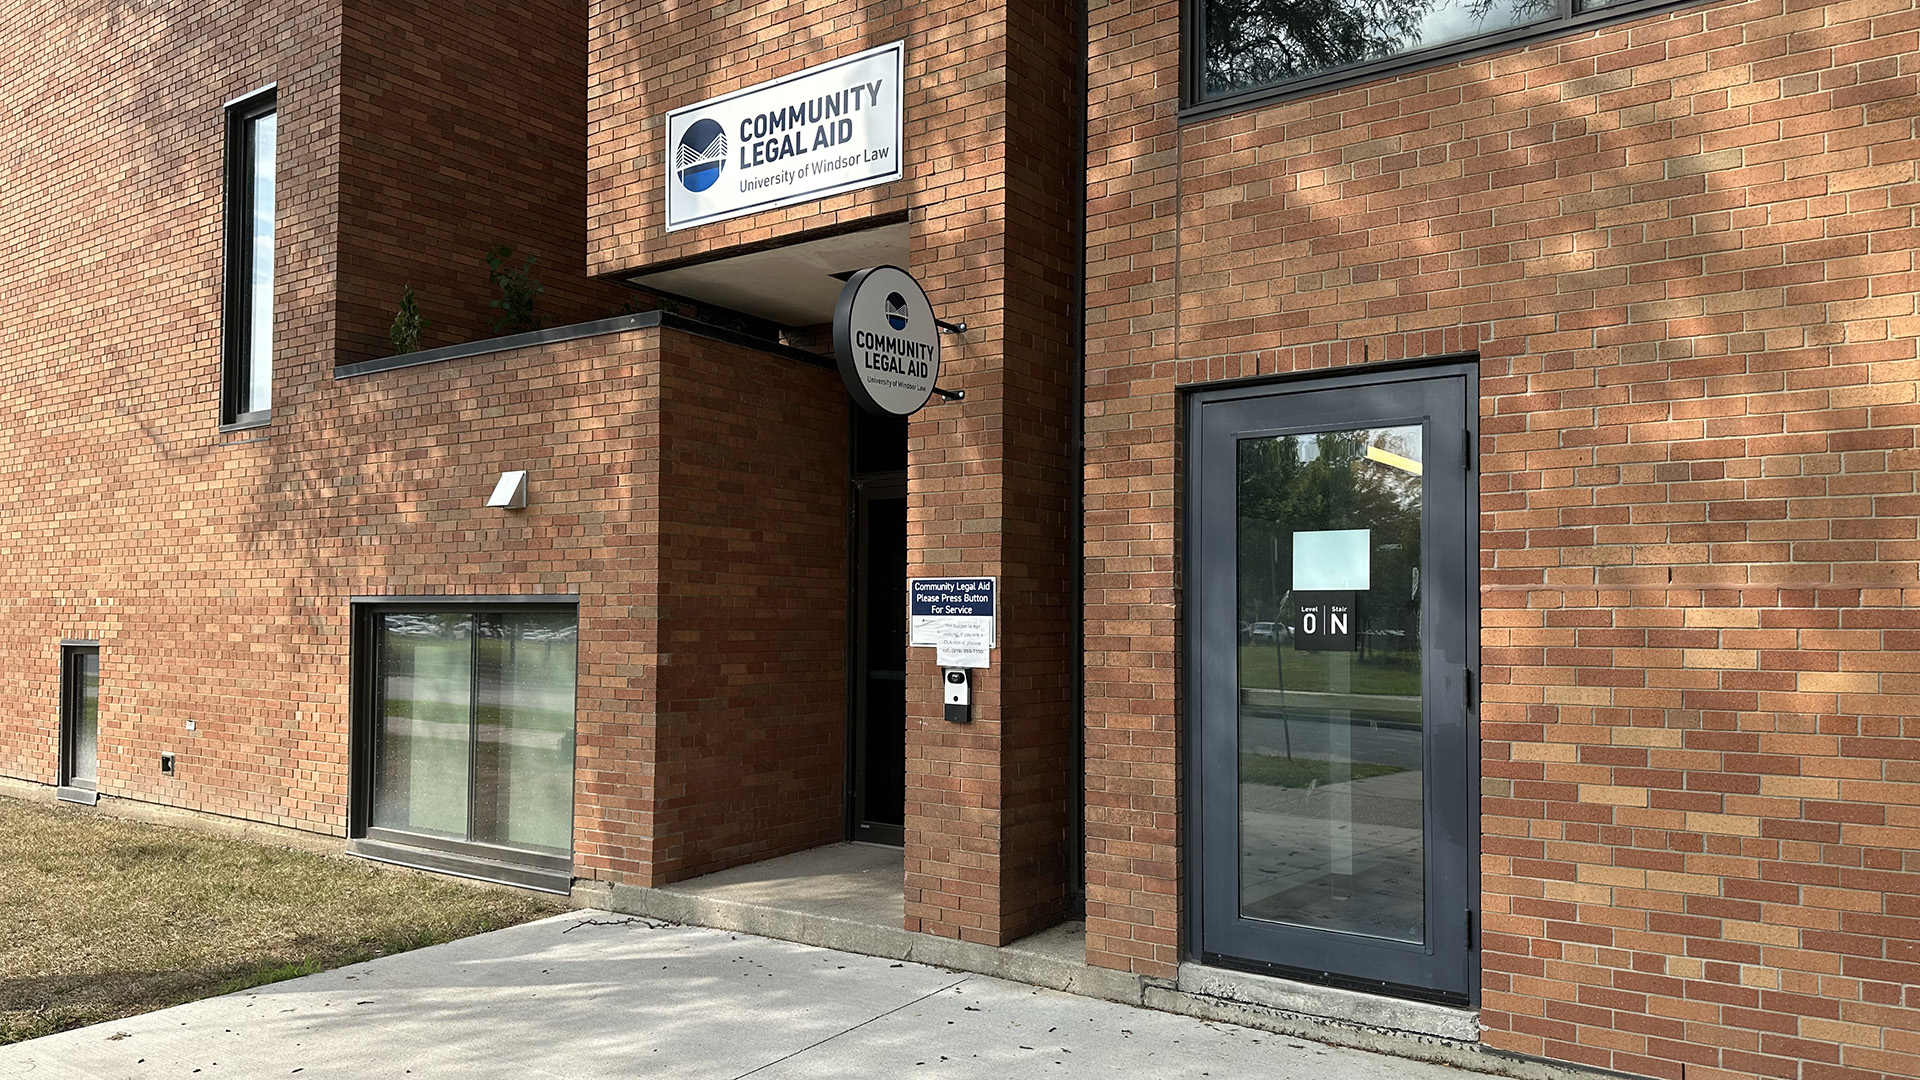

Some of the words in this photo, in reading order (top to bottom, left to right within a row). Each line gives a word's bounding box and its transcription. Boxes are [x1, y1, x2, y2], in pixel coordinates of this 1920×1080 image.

[740, 79, 882, 142] COMMUNITY
[740, 131, 807, 169] LEGAL
[812, 117, 852, 151] AID
[740, 170, 795, 192] University
[797, 163, 809, 179] of
[812, 154, 861, 176] Windsor
[864, 146, 889, 163] Law
[856, 330, 934, 361] COMMUNITY
[865, 351, 905, 374] LEGAL
[908, 360, 928, 378] AID
[867, 376, 892, 388] University
[898, 381, 916, 390] Windsor
[914, 582, 955, 592] Community
[956, 582, 976, 592] Legal
[978, 582, 990, 590] Aid
[916, 594, 940, 602] Please
[942, 594, 962, 602] Press
[964, 594, 988, 602] Button
[932, 605, 943, 614] For
[946, 605, 972, 614] Service
[1331, 613, 1348, 634] N
